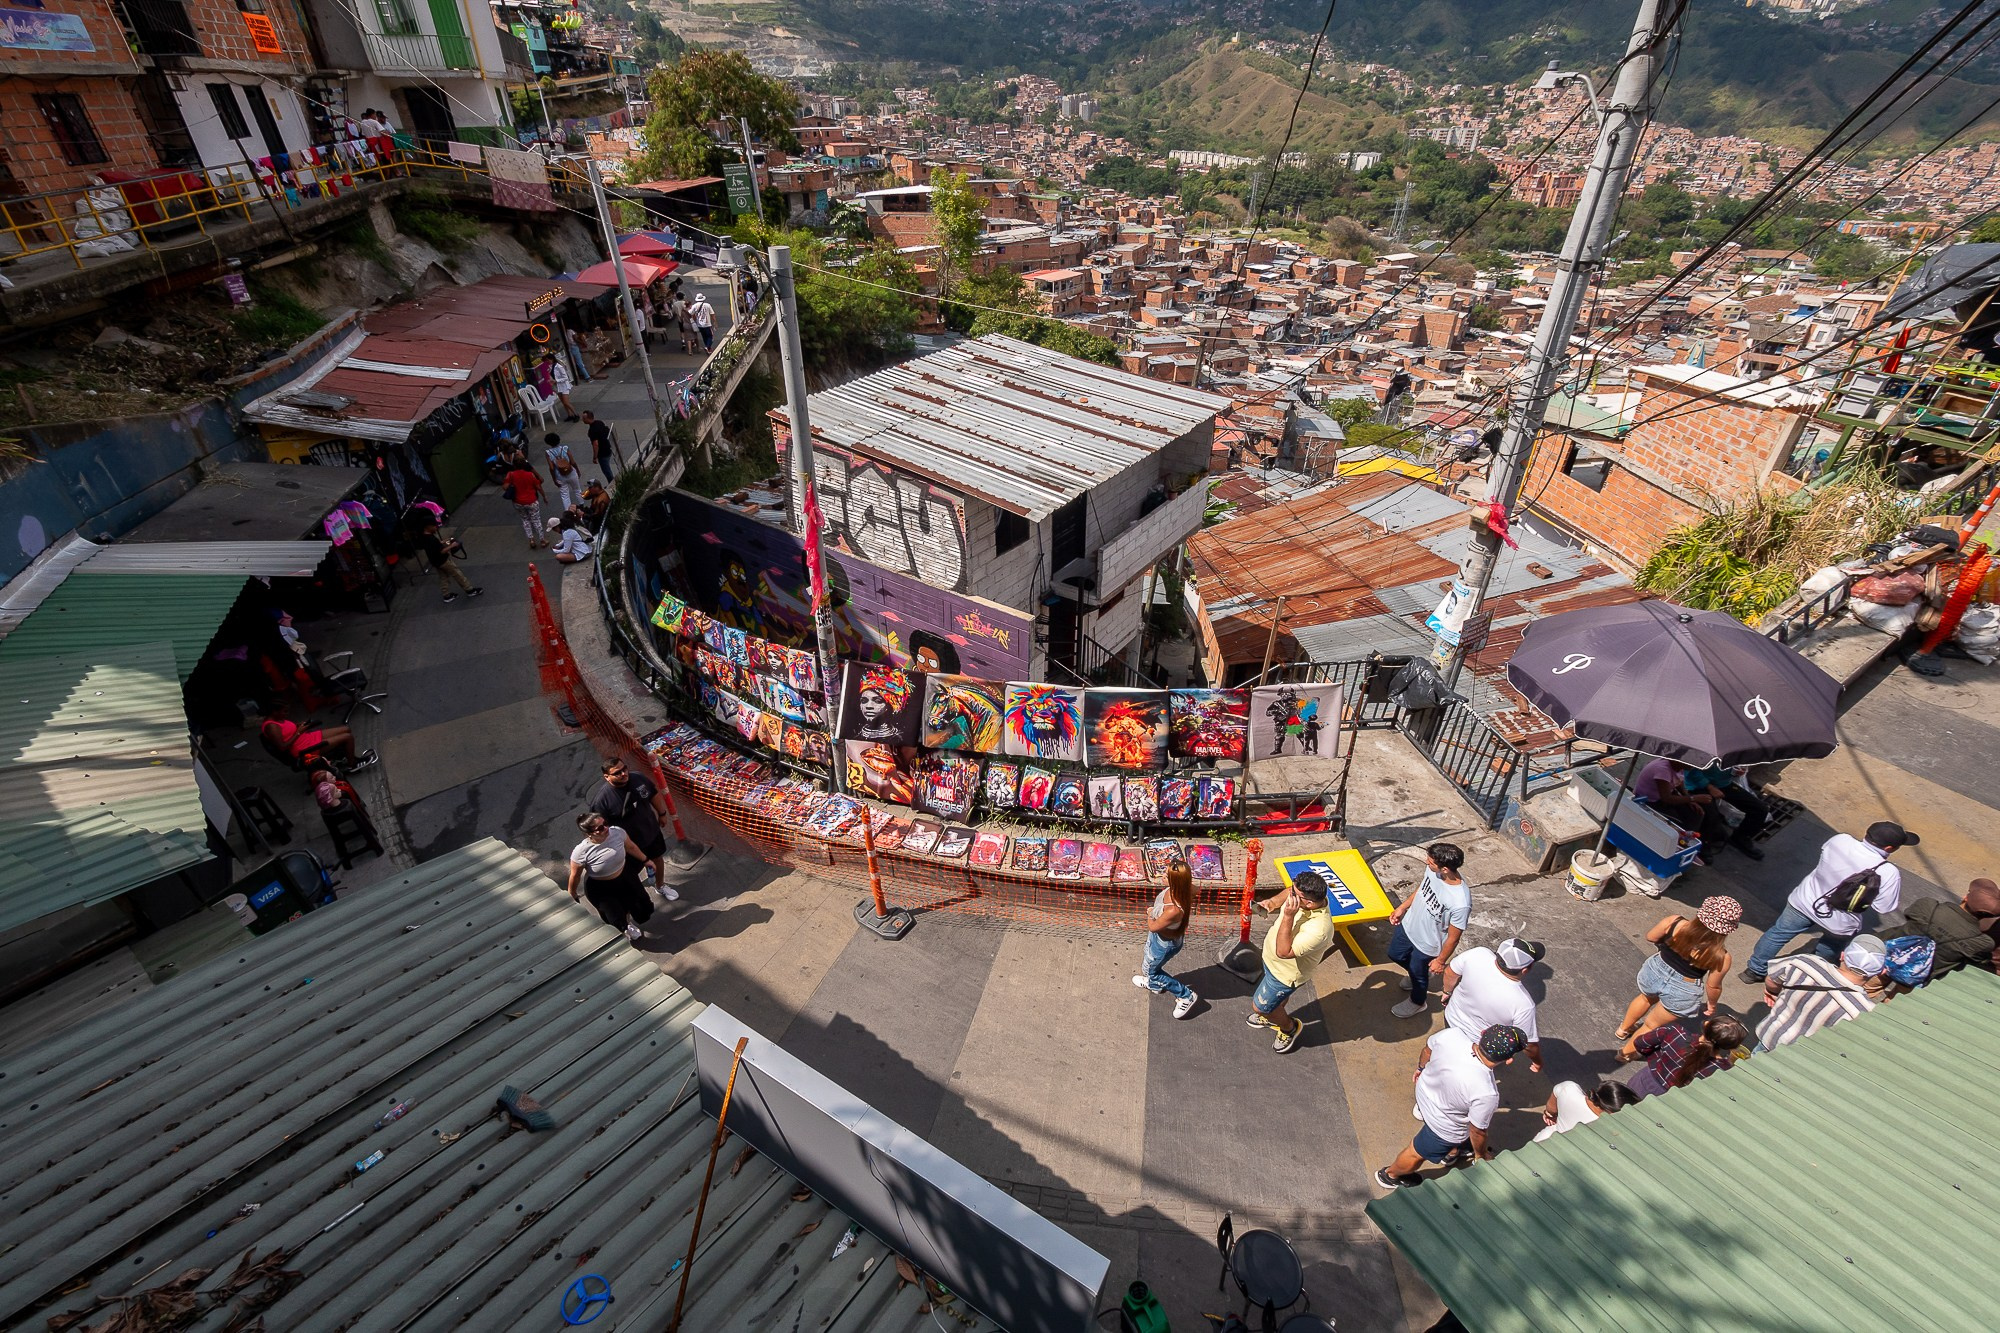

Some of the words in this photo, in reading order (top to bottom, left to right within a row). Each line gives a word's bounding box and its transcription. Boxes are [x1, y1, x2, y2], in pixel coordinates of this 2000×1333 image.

[1195, 746, 1224, 754] MARVEL
[936, 785, 954, 802] MARVEL
[925, 798, 964, 814] HEROES
[257, 886, 281, 903] VISA
[1308, 864, 1359, 909] AGUILA
